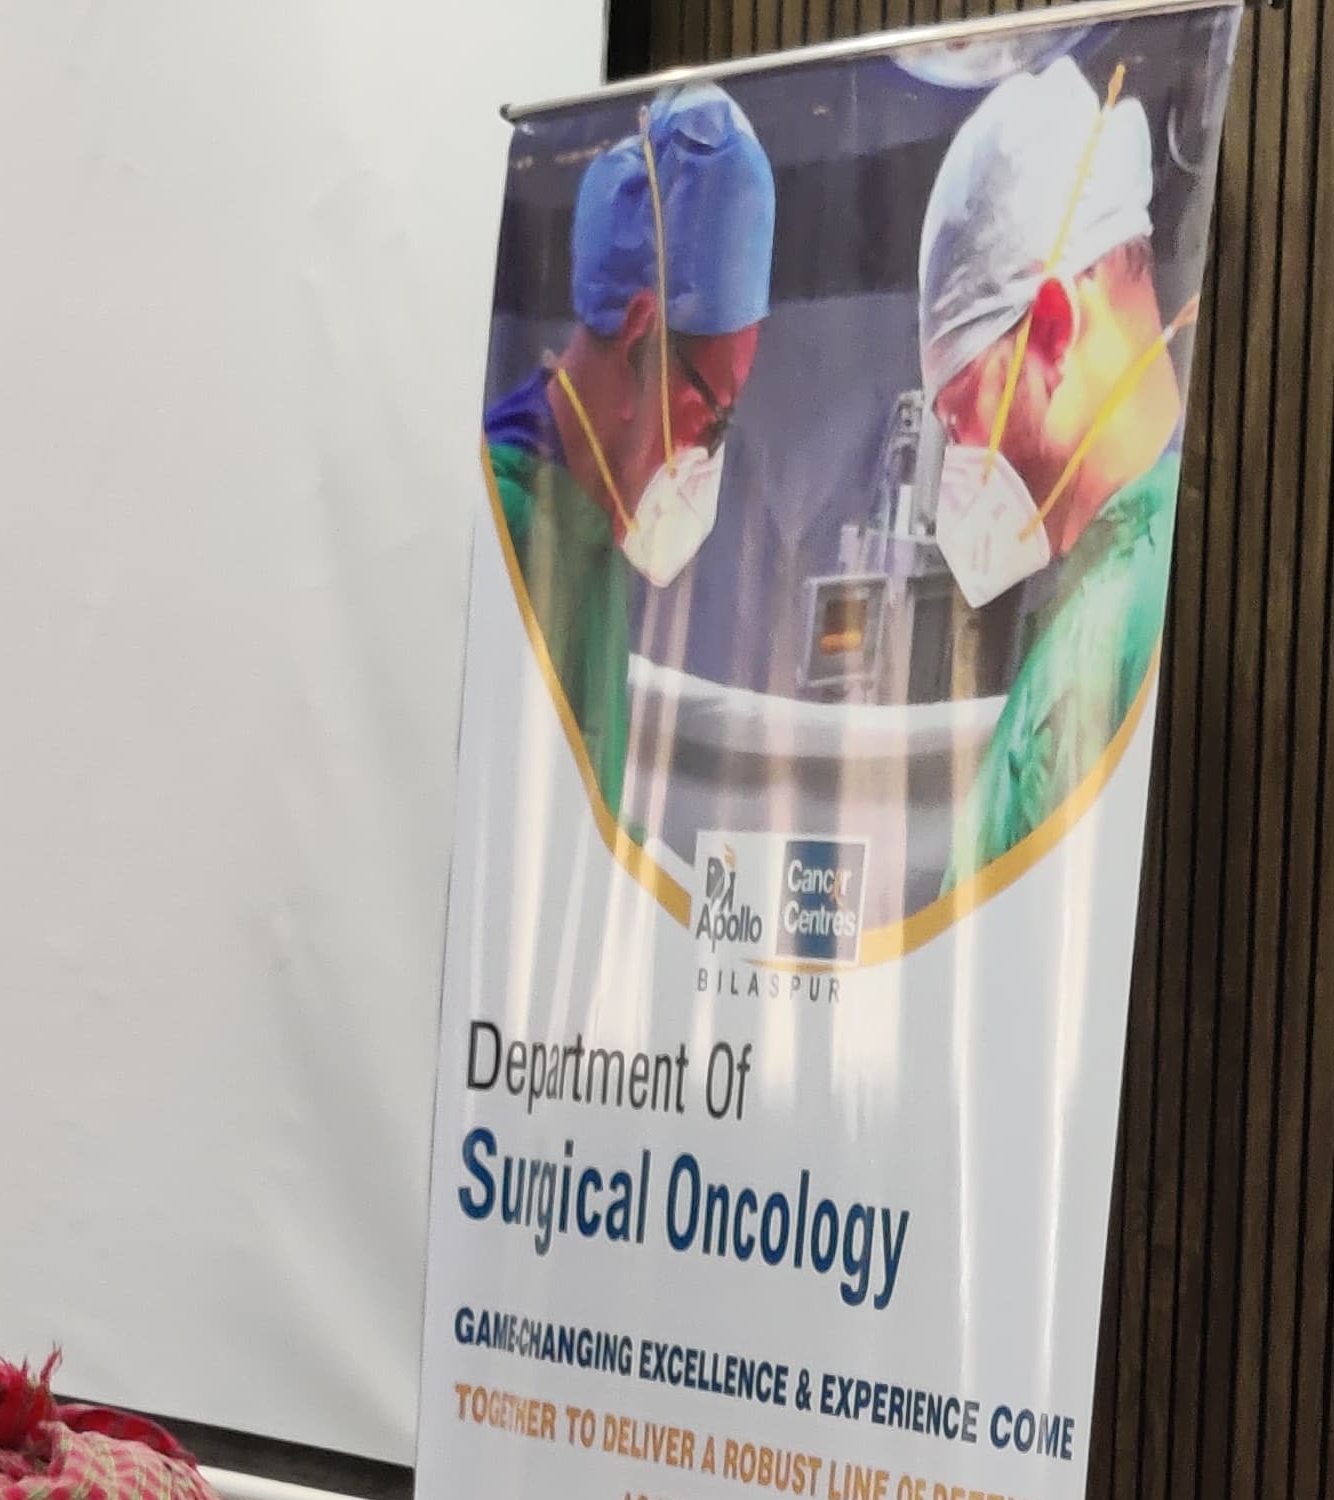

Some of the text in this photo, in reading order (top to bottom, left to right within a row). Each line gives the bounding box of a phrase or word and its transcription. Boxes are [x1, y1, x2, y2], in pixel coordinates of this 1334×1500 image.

[695, 903, 763, 953] Apollo
[784, 900, 856, 937] Centres
[697, 967, 841, 1004] BILASPUR
[467, 1020, 753, 1121] Department Of
[458, 1126, 910, 1311] Surgical Oncology
[454, 1382, 556, 1441] TOGETHER
[567, 1409, 598, 1450] TO
[603, 1416, 696, 1476] DELIVER
[701, 1436, 717, 1475] A
[723, 1439, 823, 1499] ROBUST
[639, 1339, 788, 1406] EXCELLENCE
[795, 1371, 813, 1411] &
[819, 1373, 978, 1445] EXPERIENCE
[988, 1404, 1075, 1462] COME
